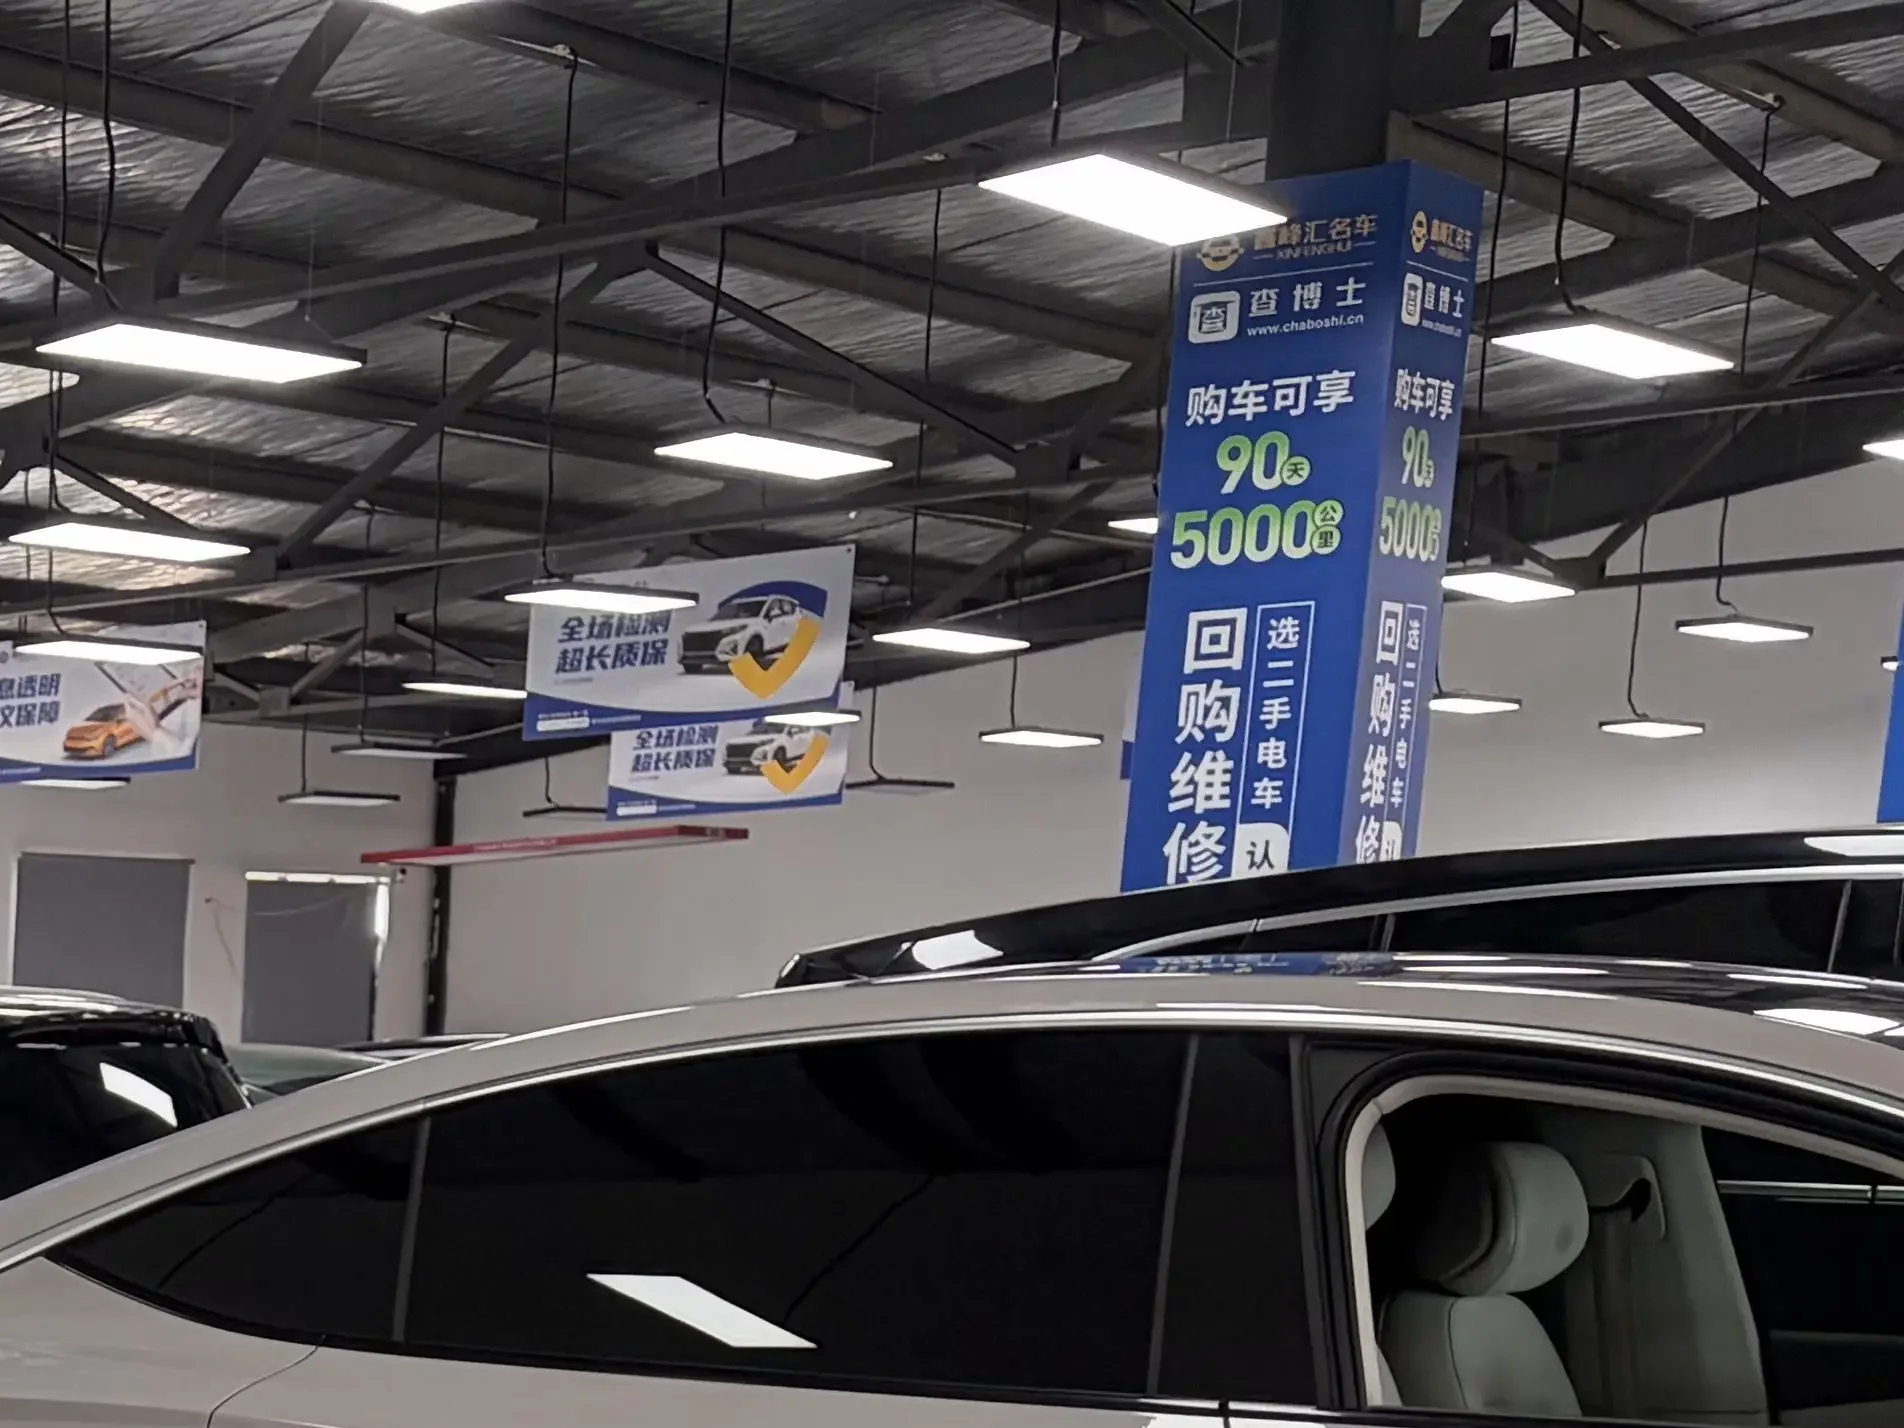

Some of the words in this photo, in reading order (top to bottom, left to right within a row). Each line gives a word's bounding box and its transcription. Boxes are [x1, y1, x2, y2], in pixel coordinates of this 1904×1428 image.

[1248, 276, 1367, 318] 查博士
[1247, 312, 1364, 337] www.chaboshi.cn
[1185, 369, 1356, 427] 购车可享
[1394, 368, 1455, 421] 购车可享
[557, 611, 672, 643] 全场检测
[555, 638, 669, 674] 超长质保
[1250, 616, 1300, 809] 选二手电车
[631, 748, 717, 774] 超长质保
[1162, 607, 1248, 885] 回购维修
